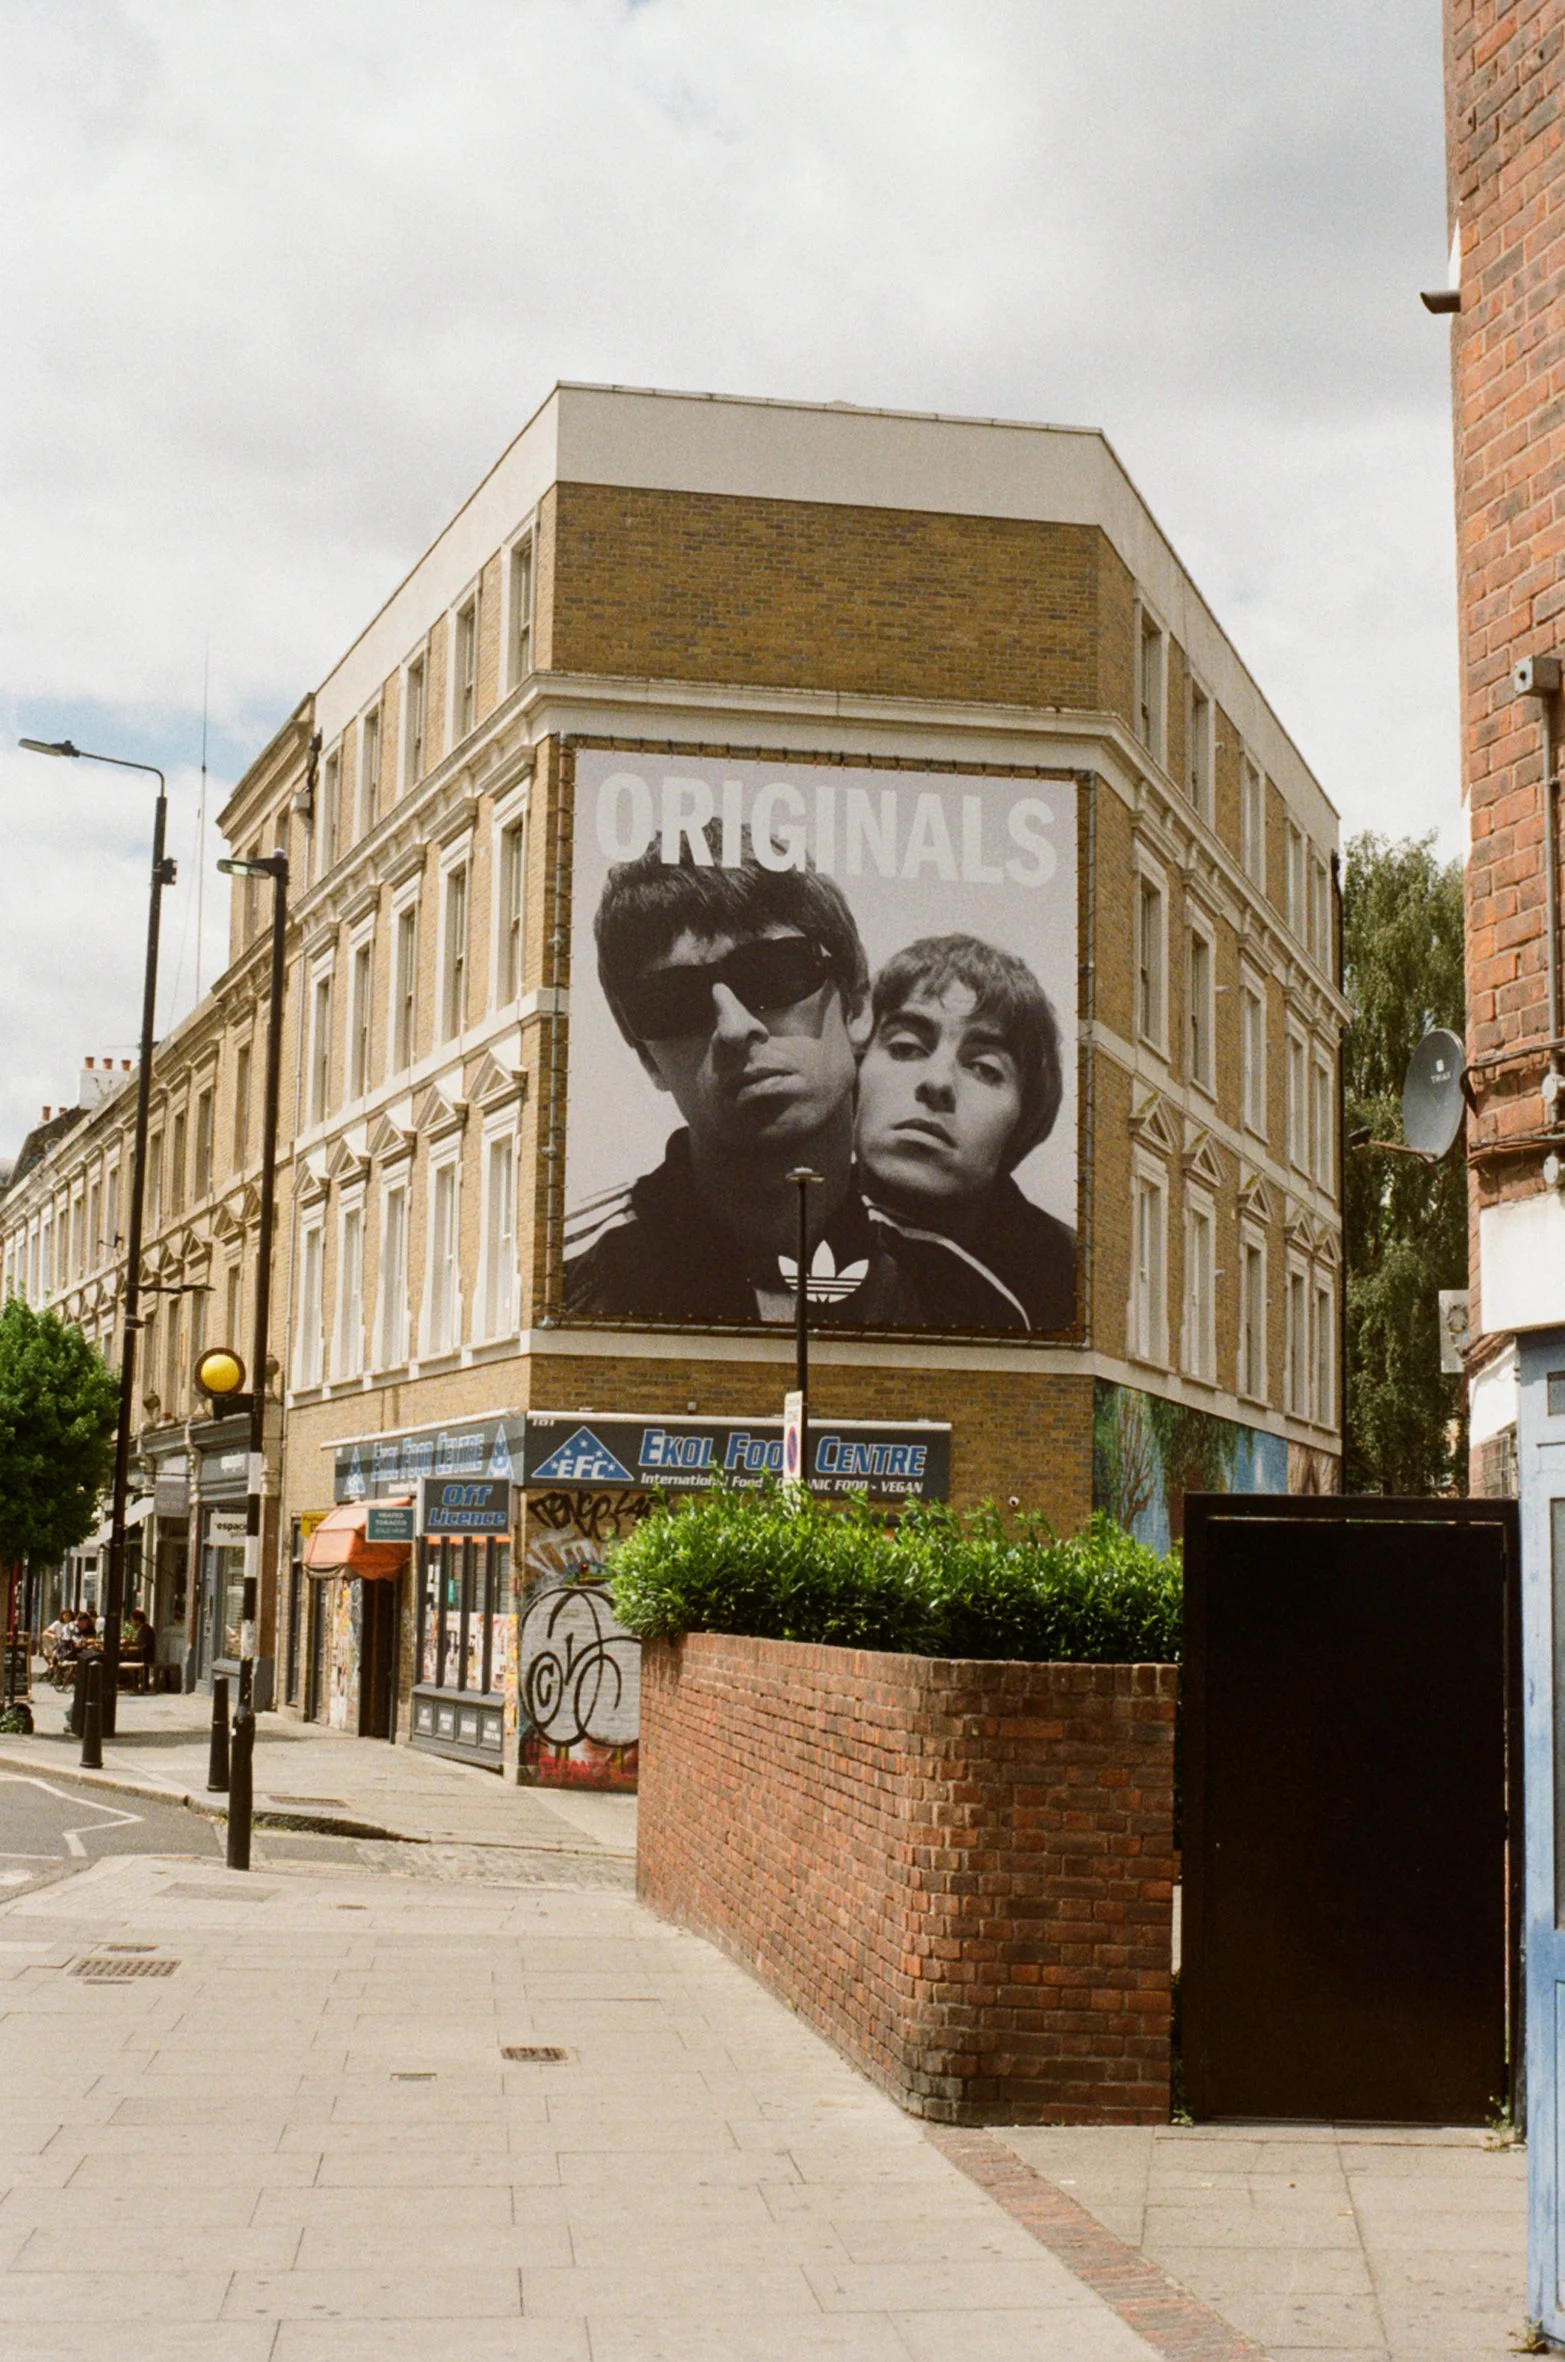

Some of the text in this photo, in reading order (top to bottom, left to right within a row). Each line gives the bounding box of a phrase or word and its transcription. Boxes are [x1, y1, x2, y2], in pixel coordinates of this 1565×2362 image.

[595, 772, 1057, 888] ORIGINALS
[638, 1429, 927, 1476] EKOL FOO CENTRE
[557, 1455, 608, 1480] EFC
[442, 1484, 493, 1506] Off
[835, 1480, 869, 1491] FOOD
[881, 1480, 924, 1494] VEGAN
[428, 1507, 507, 1527] Licence
